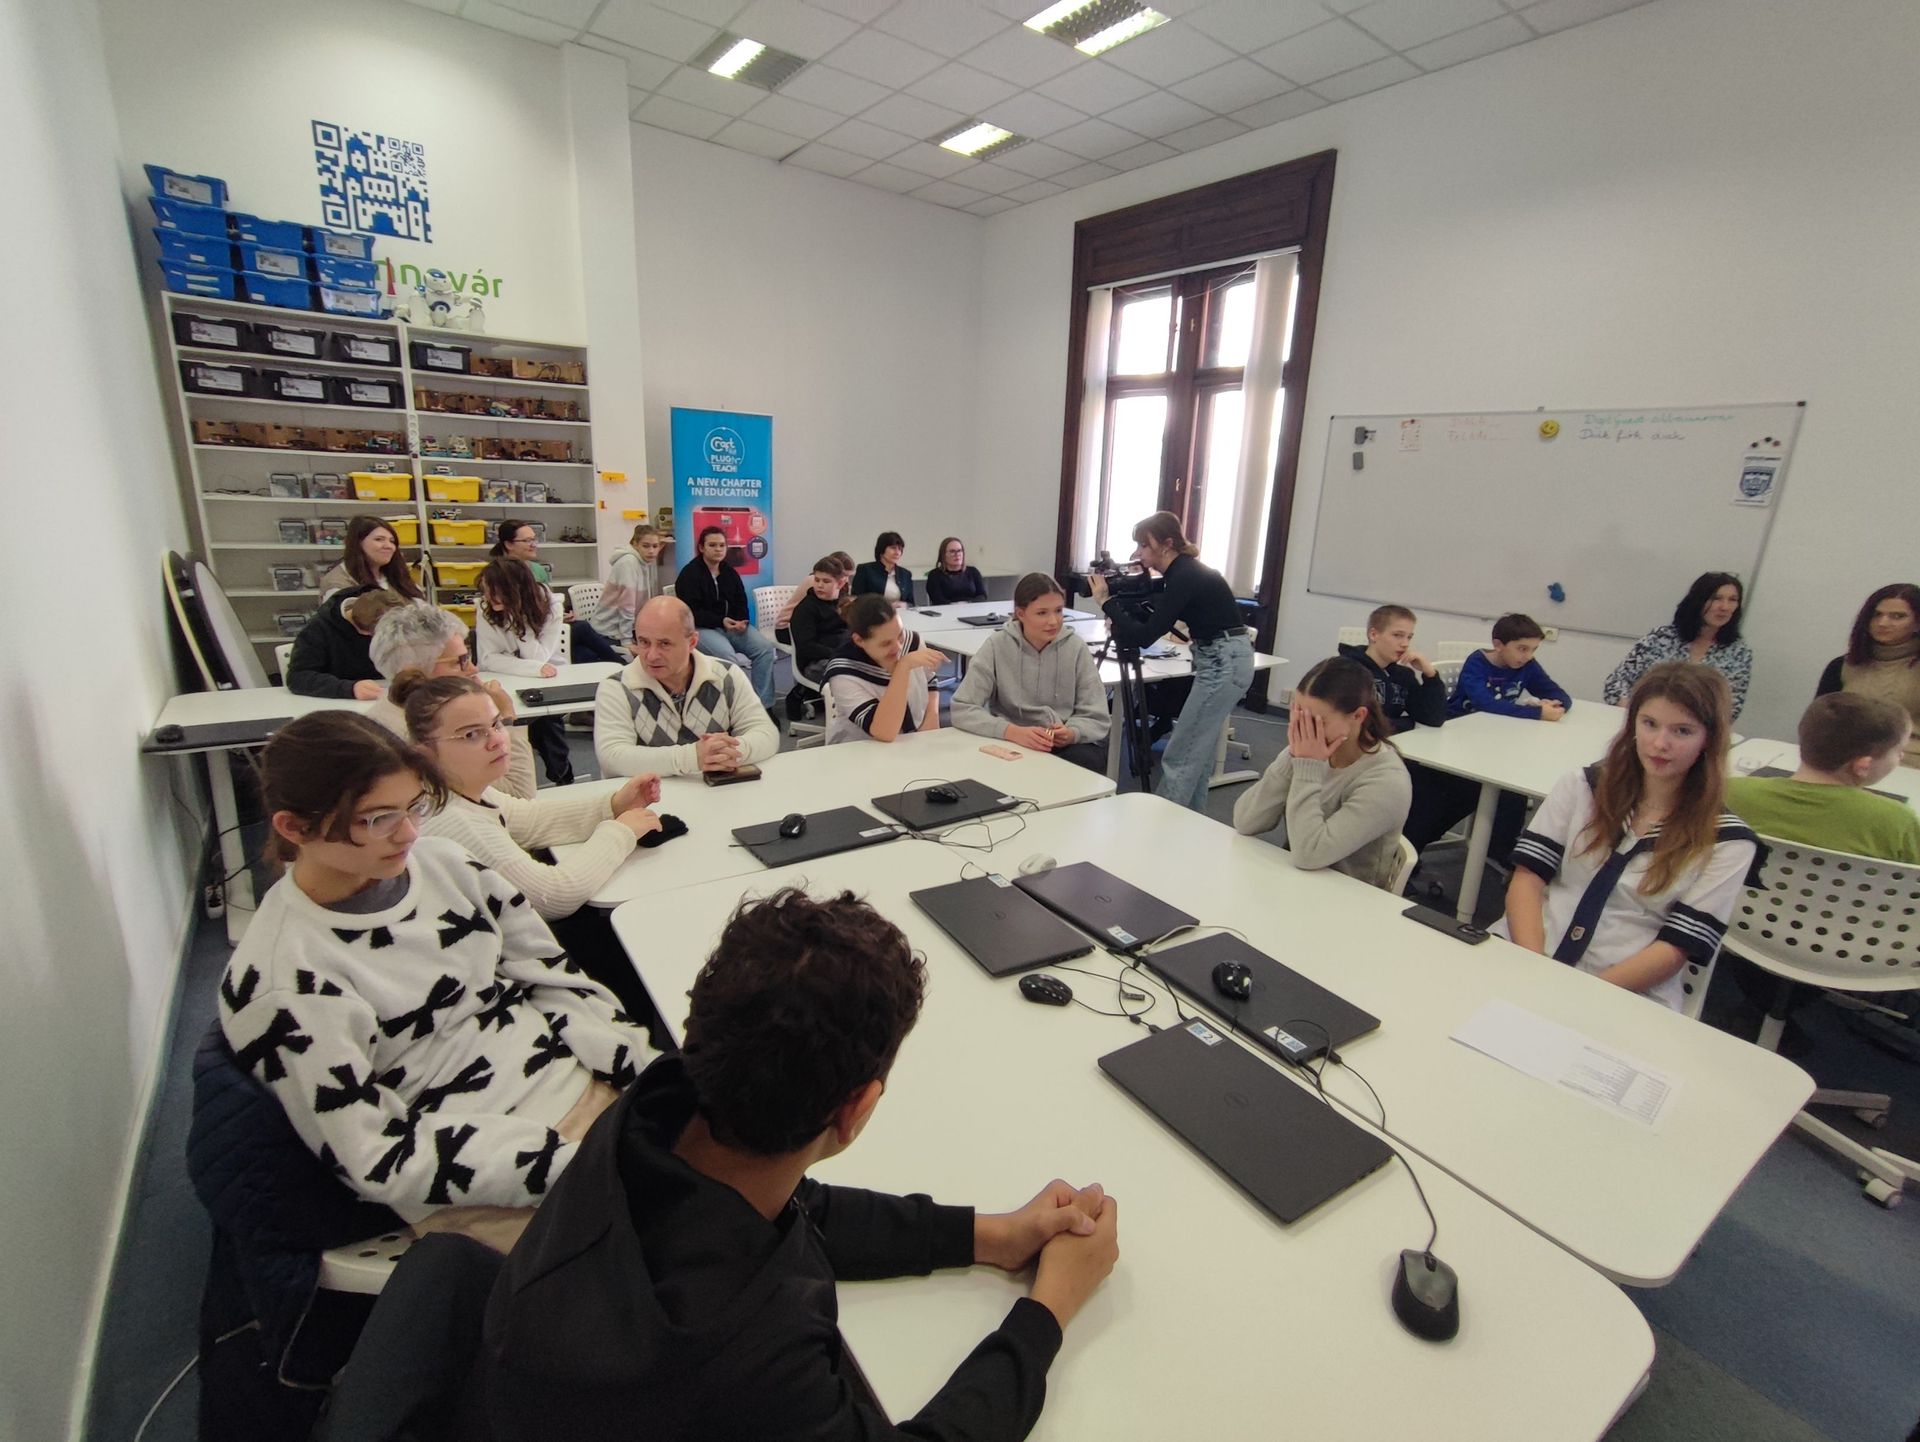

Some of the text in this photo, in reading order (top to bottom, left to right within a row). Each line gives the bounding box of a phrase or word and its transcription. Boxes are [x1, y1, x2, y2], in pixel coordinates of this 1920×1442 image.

[687, 477, 762, 489] A NEW CHAPTER
[691, 487, 759, 498] IN EDUCATION
